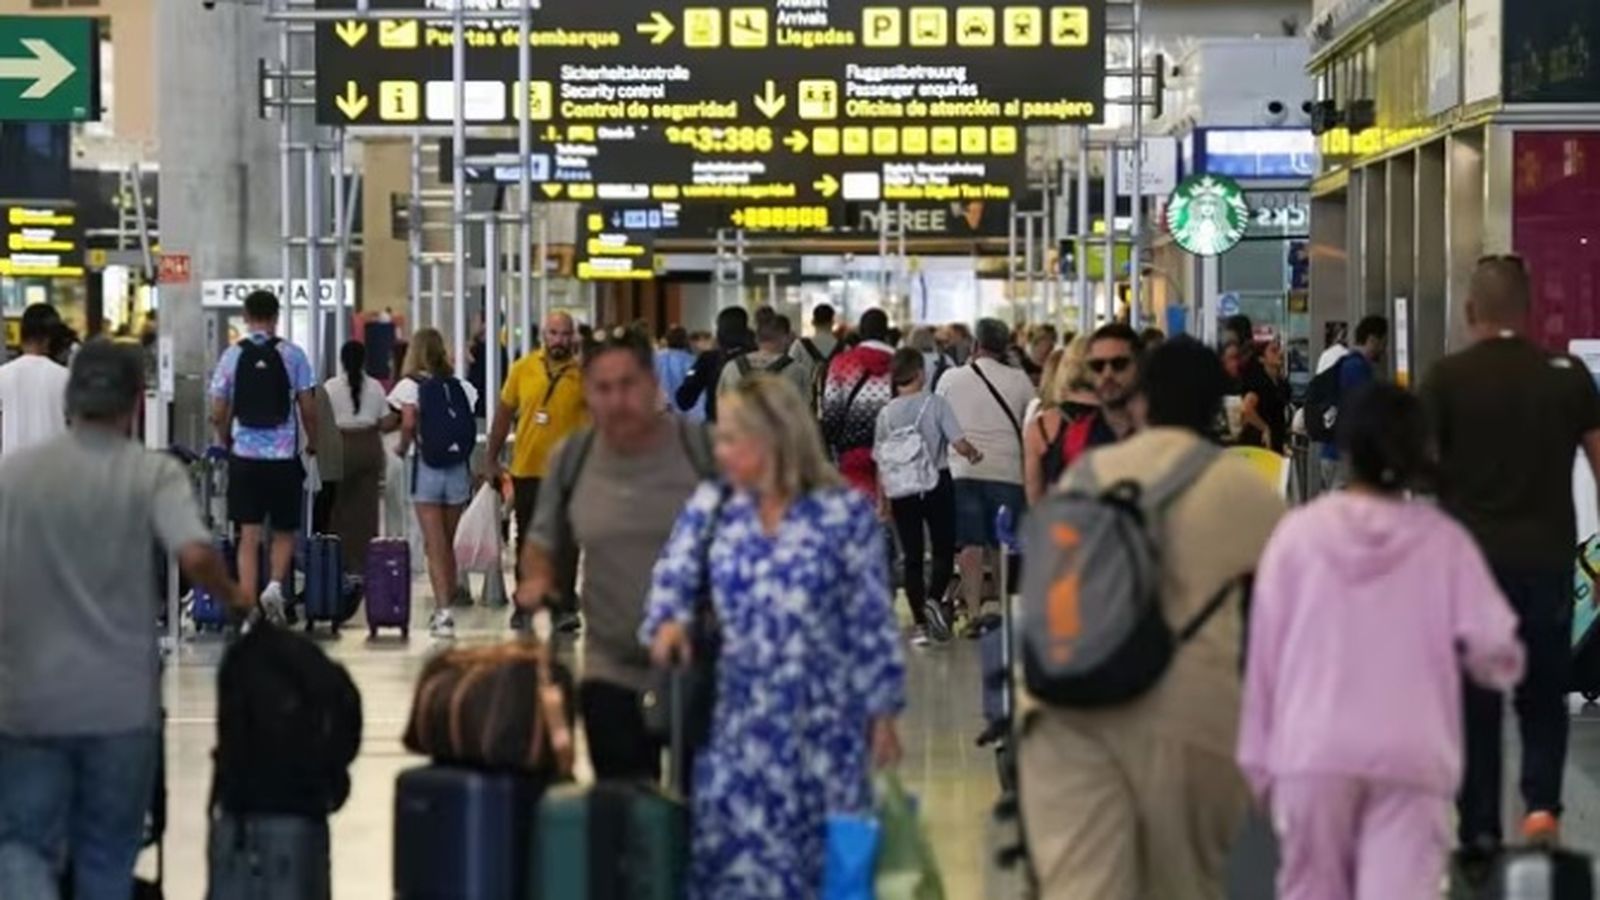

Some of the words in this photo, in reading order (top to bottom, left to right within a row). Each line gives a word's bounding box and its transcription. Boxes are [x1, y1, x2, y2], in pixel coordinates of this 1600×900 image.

[777, 10, 828, 25] Arrivals
[530, 28, 620, 49] embarque
[777, 27, 855, 48] Llegadas
[560, 83, 615, 100] Security
[617, 83, 666, 99] control
[845, 81, 914, 98] Passenger
[918, 81, 979, 98] enquiries
[560, 101, 625, 118] Control
[627, 101, 649, 118] de
[652, 101, 738, 121] seguridad
[845, 99, 903, 117] Oficina
[906, 99, 927, 117] de
[930, 98, 1000, 117] atención
[1004, 99, 1020, 116] al
[1023, 99, 1094, 119] pasajero
